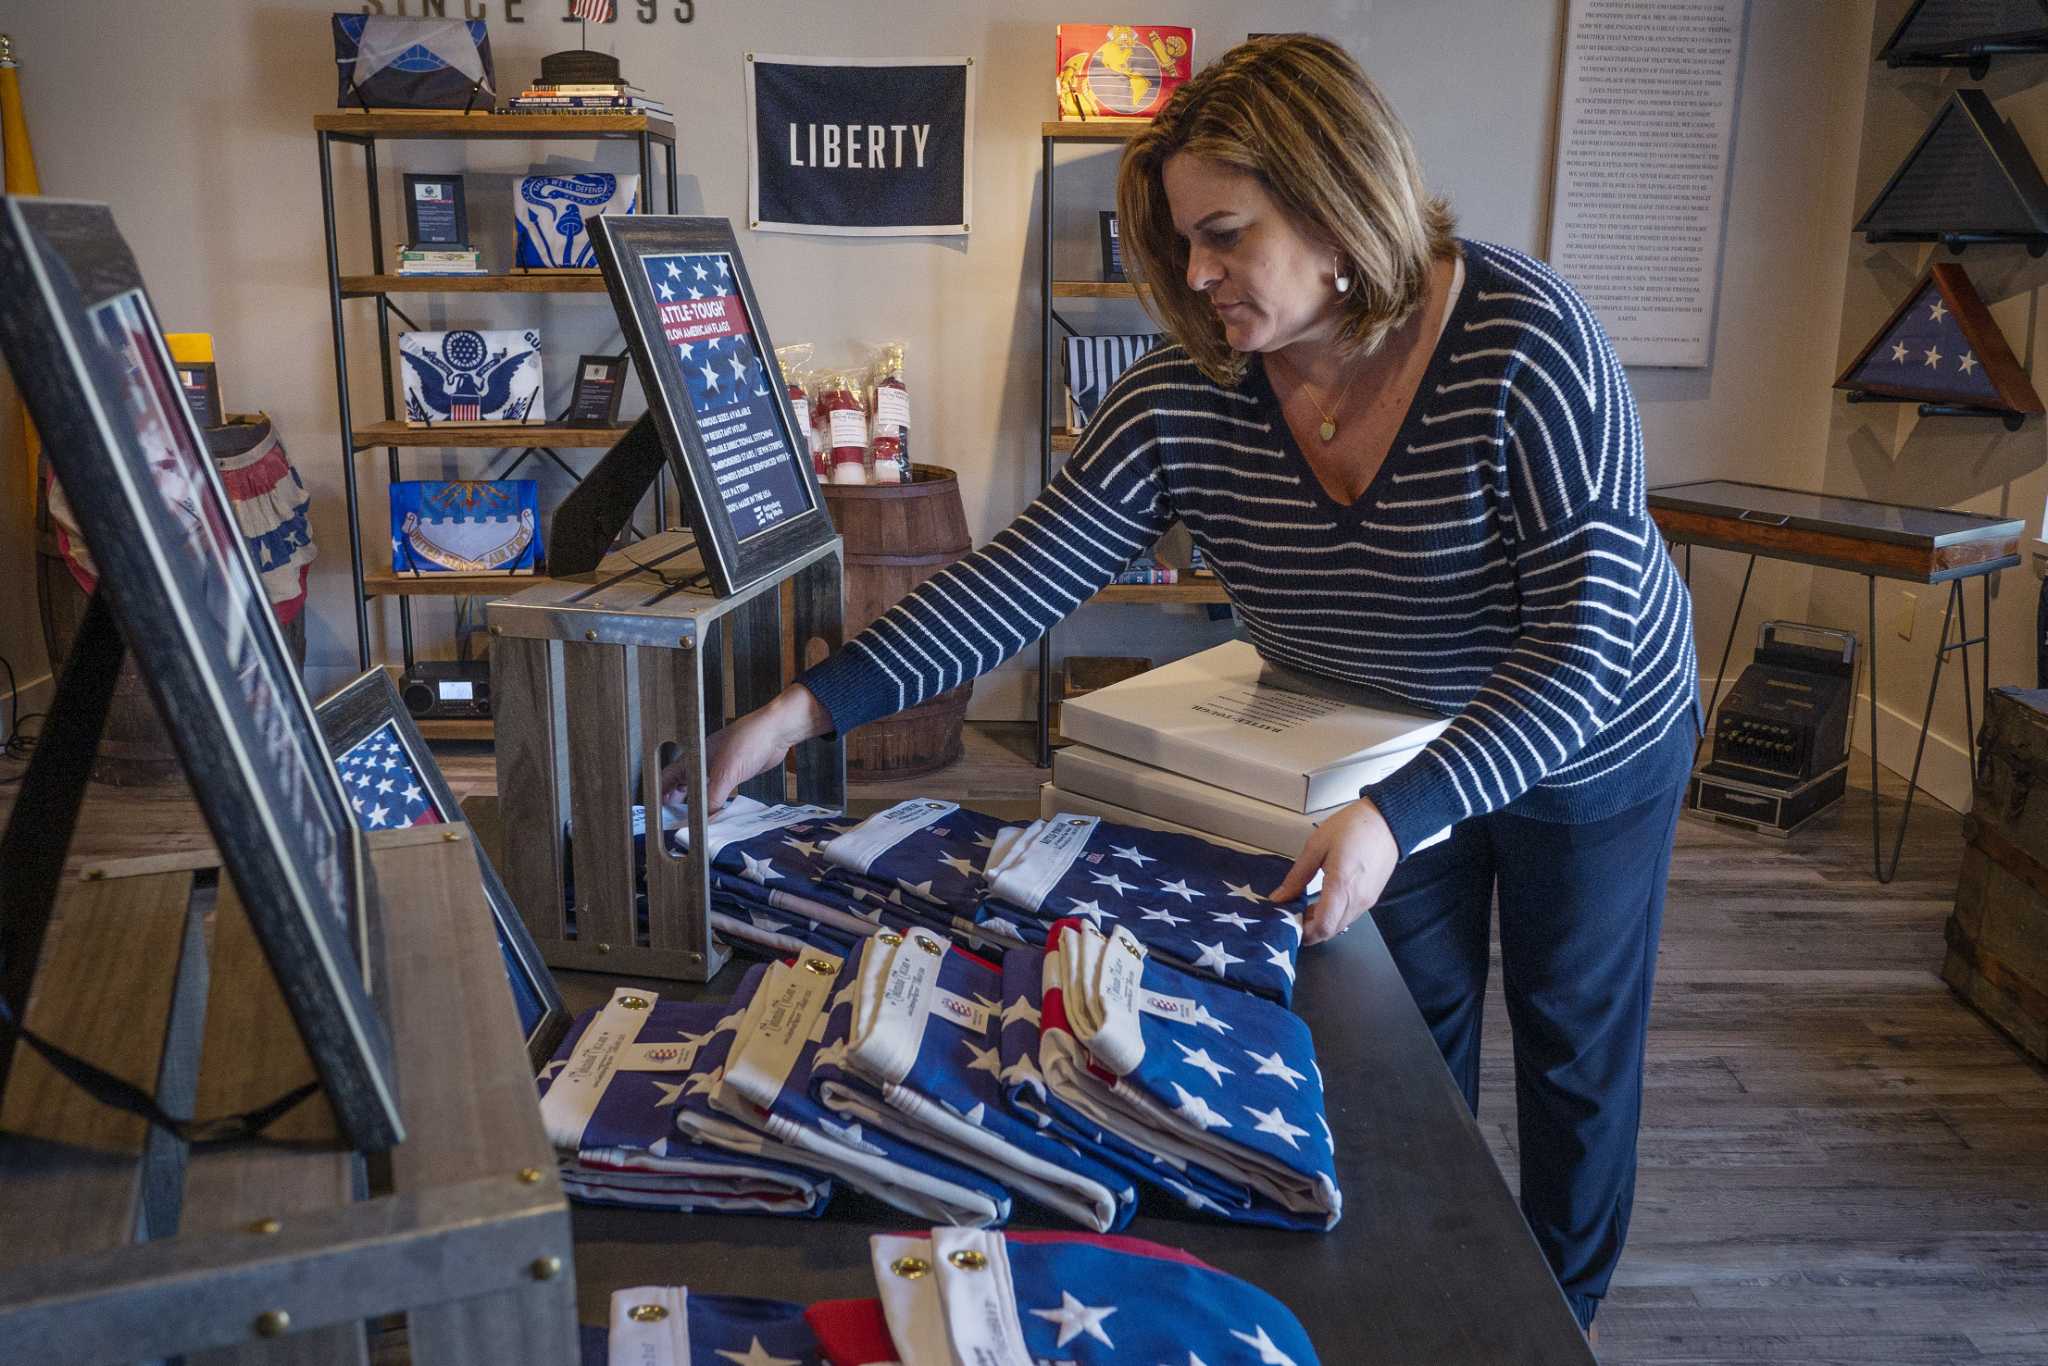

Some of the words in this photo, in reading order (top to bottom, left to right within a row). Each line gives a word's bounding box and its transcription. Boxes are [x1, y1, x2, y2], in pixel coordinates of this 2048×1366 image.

[790, 123, 930, 168] LIBERTY
[575, 184, 604, 195] DEFEND
[660, 301, 725, 325] ATTLE-TOUGH
[683, 323, 713, 339] AMERICAN
[711, 320, 731, 334] FLAGS
[523, 331, 541, 352] GU
[729, 406, 752, 420] AVAILABLE
